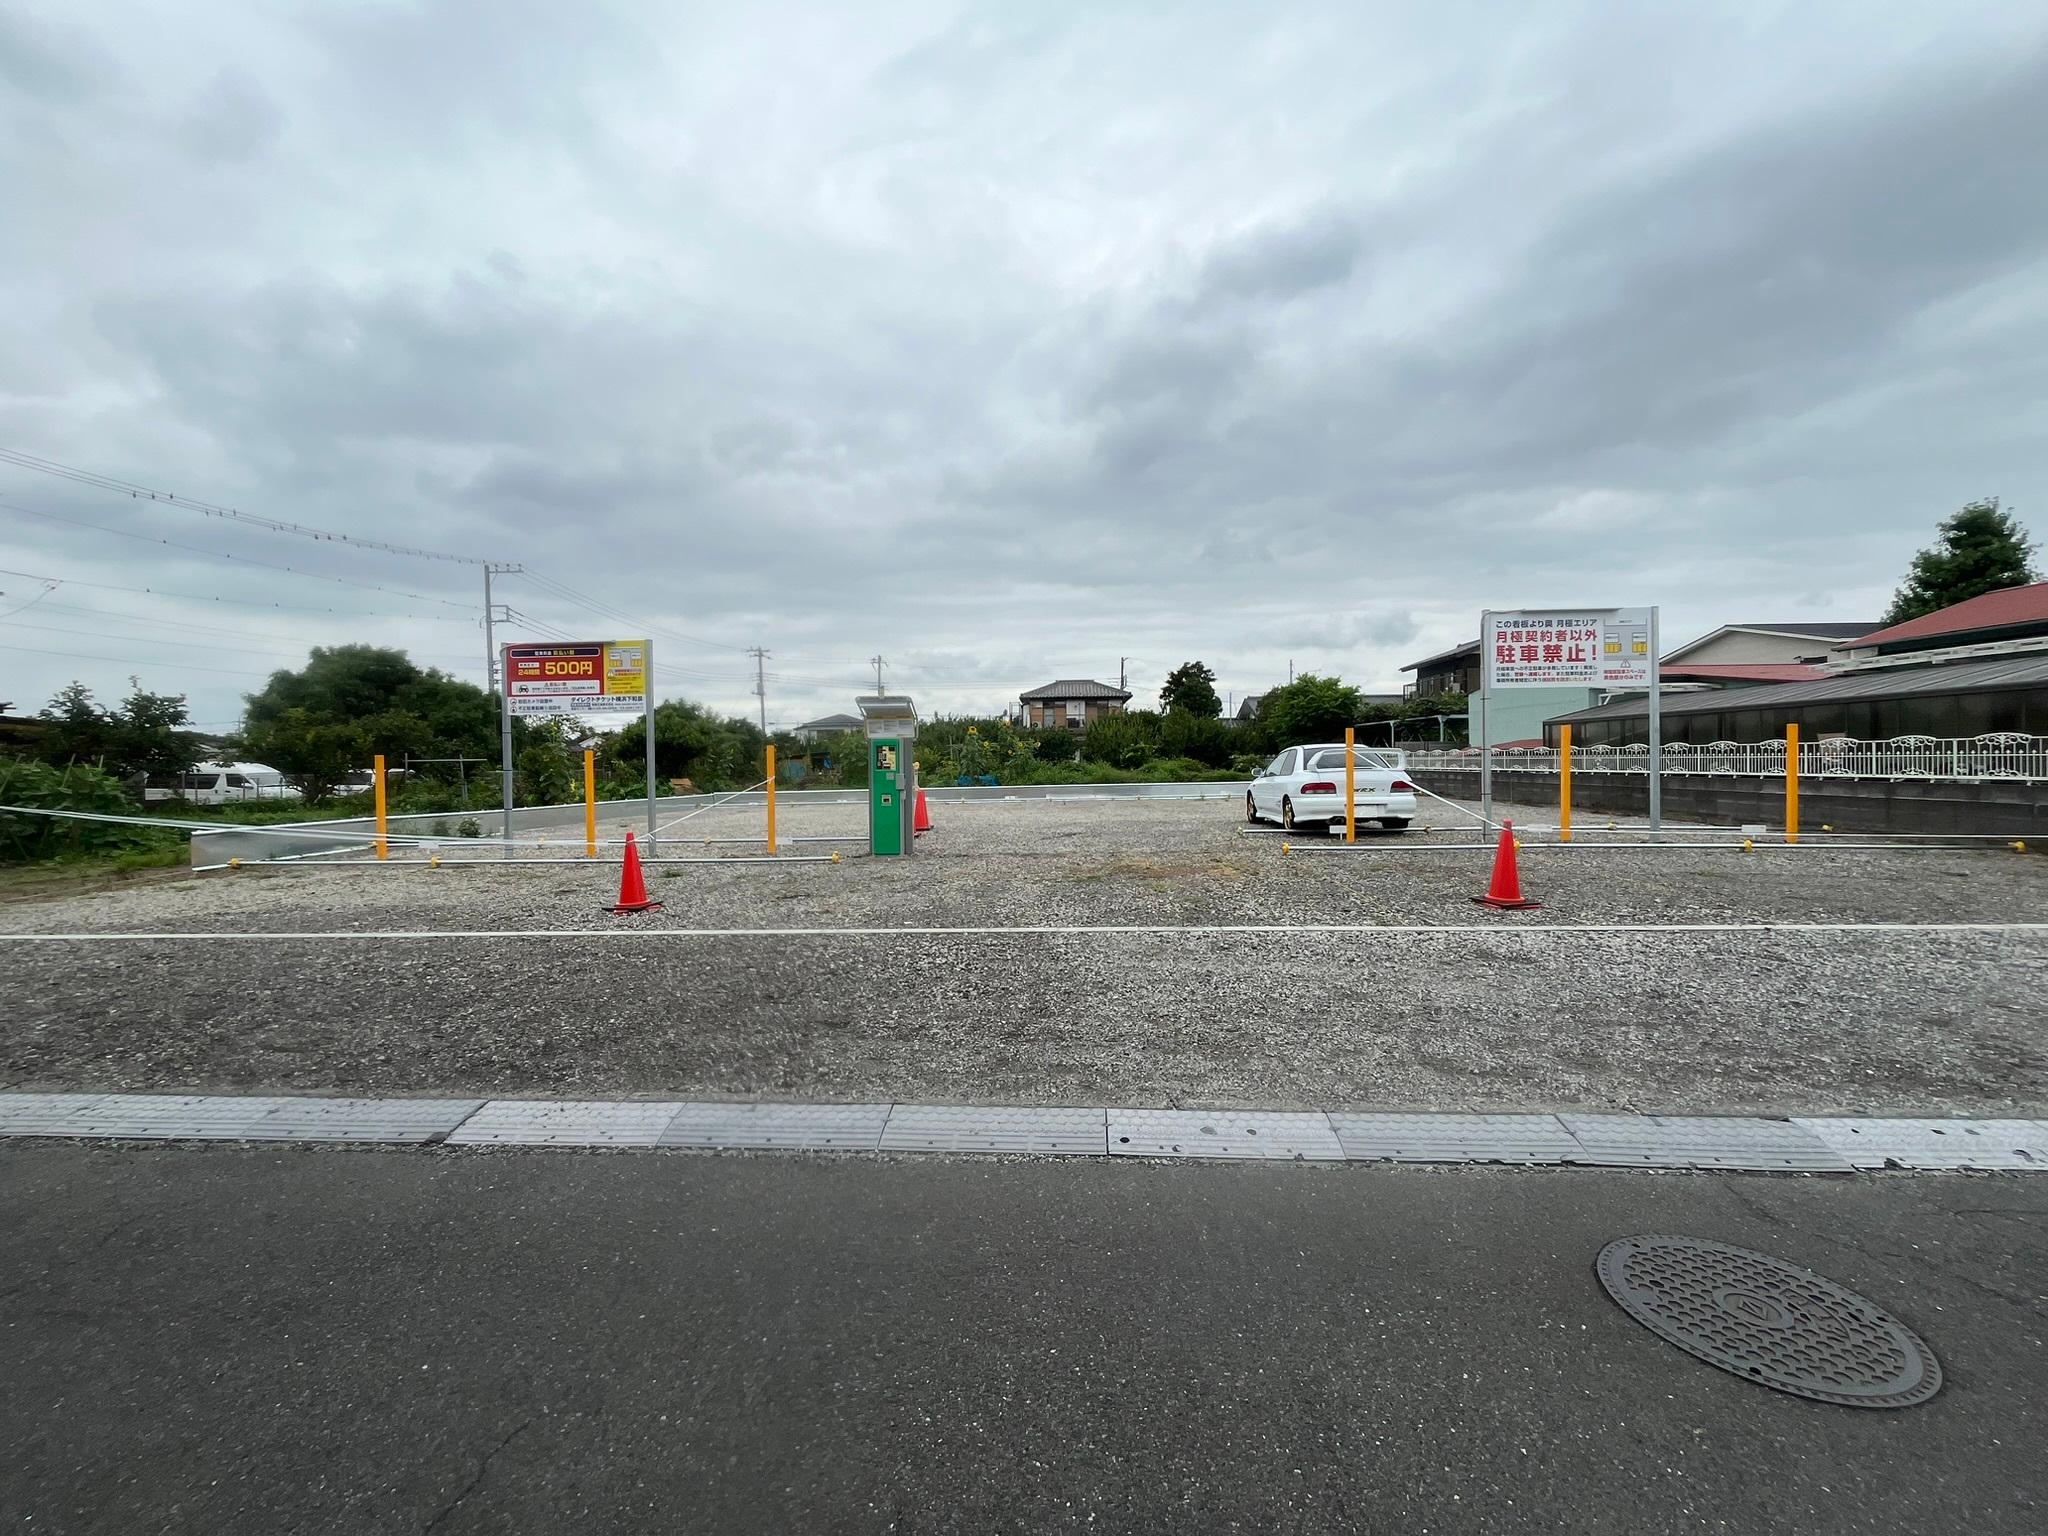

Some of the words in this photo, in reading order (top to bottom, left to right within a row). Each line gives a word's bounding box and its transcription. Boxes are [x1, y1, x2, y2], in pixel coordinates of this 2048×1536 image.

[1496, 620, 1553, 628] この看板より奥
[1556, 619, 1597, 628] 月極エリア
[1496, 629, 1597, 643] 月極契約者以外
[1495, 643, 1597, 664] 駐車禁止!
[518, 668, 541, 676] 24時間
[545, 661, 593, 675] 500円
